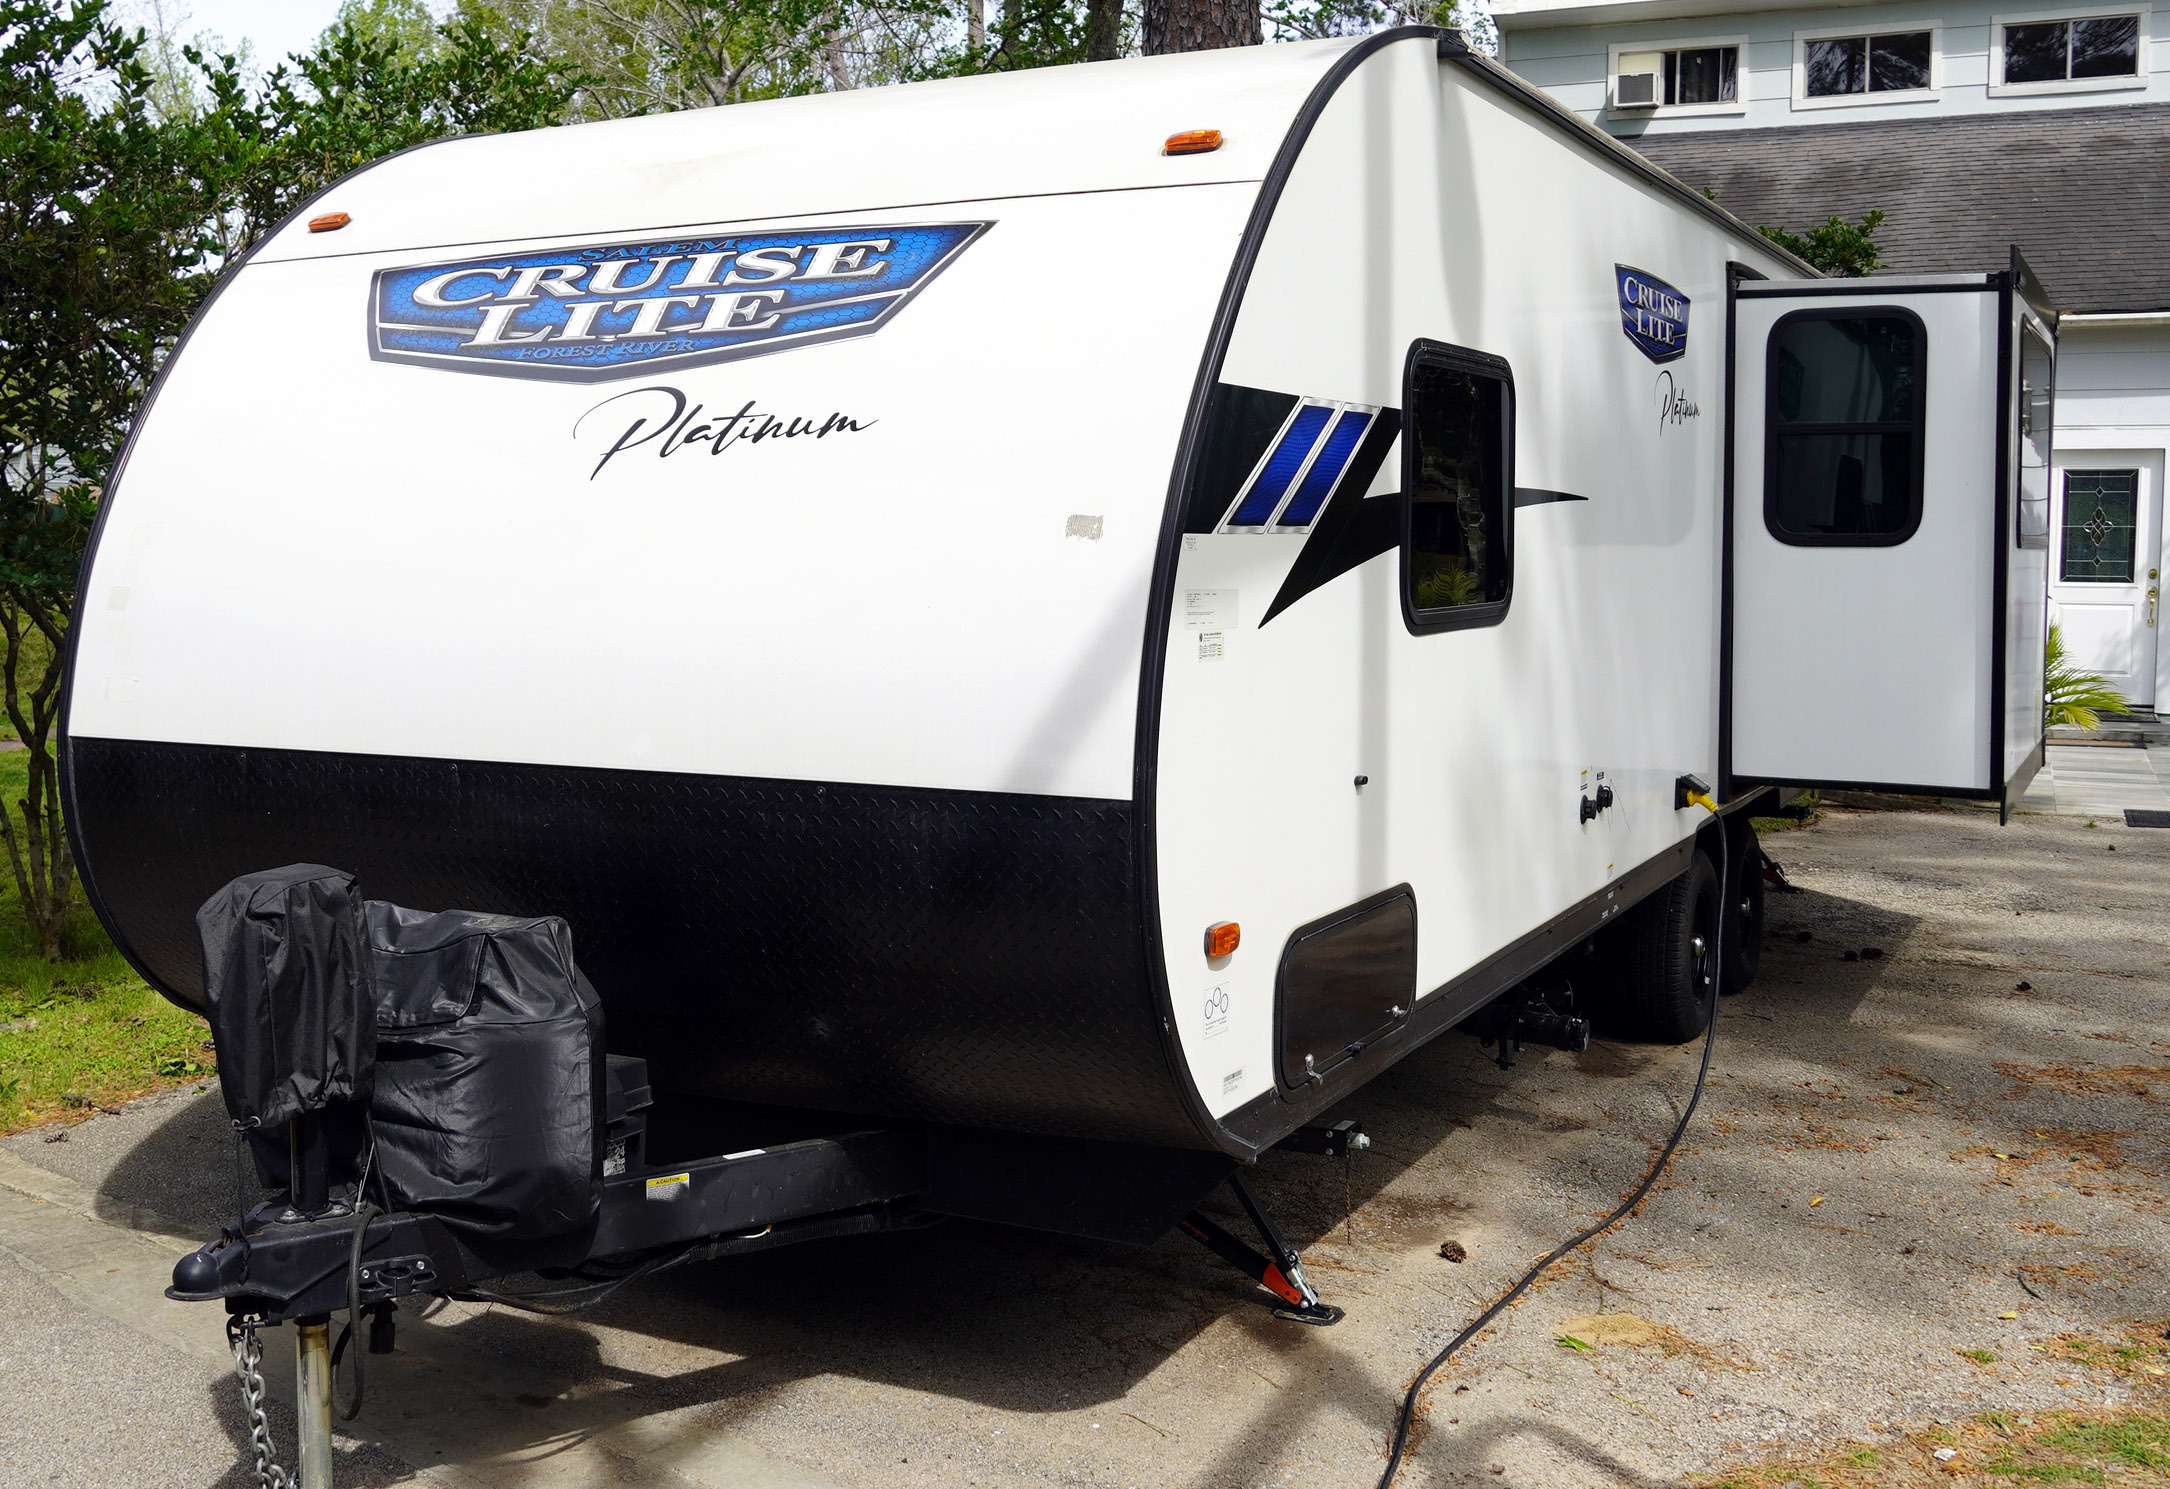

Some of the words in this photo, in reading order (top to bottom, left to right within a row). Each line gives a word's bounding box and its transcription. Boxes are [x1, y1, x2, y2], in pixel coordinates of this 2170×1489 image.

[411, 239, 892, 307] CRUISE
[580, 238, 741, 261] SALEM
[460, 289, 786, 348] LITE
[1623, 276, 1683, 323] CRUISE
[1636, 307, 1675, 345] LITE
[516, 344, 613, 361] FOREST
[615, 339, 696, 355] RIVER
[1654, 370, 1702, 437] Platinum
[573, 386, 879, 481] Platinum
